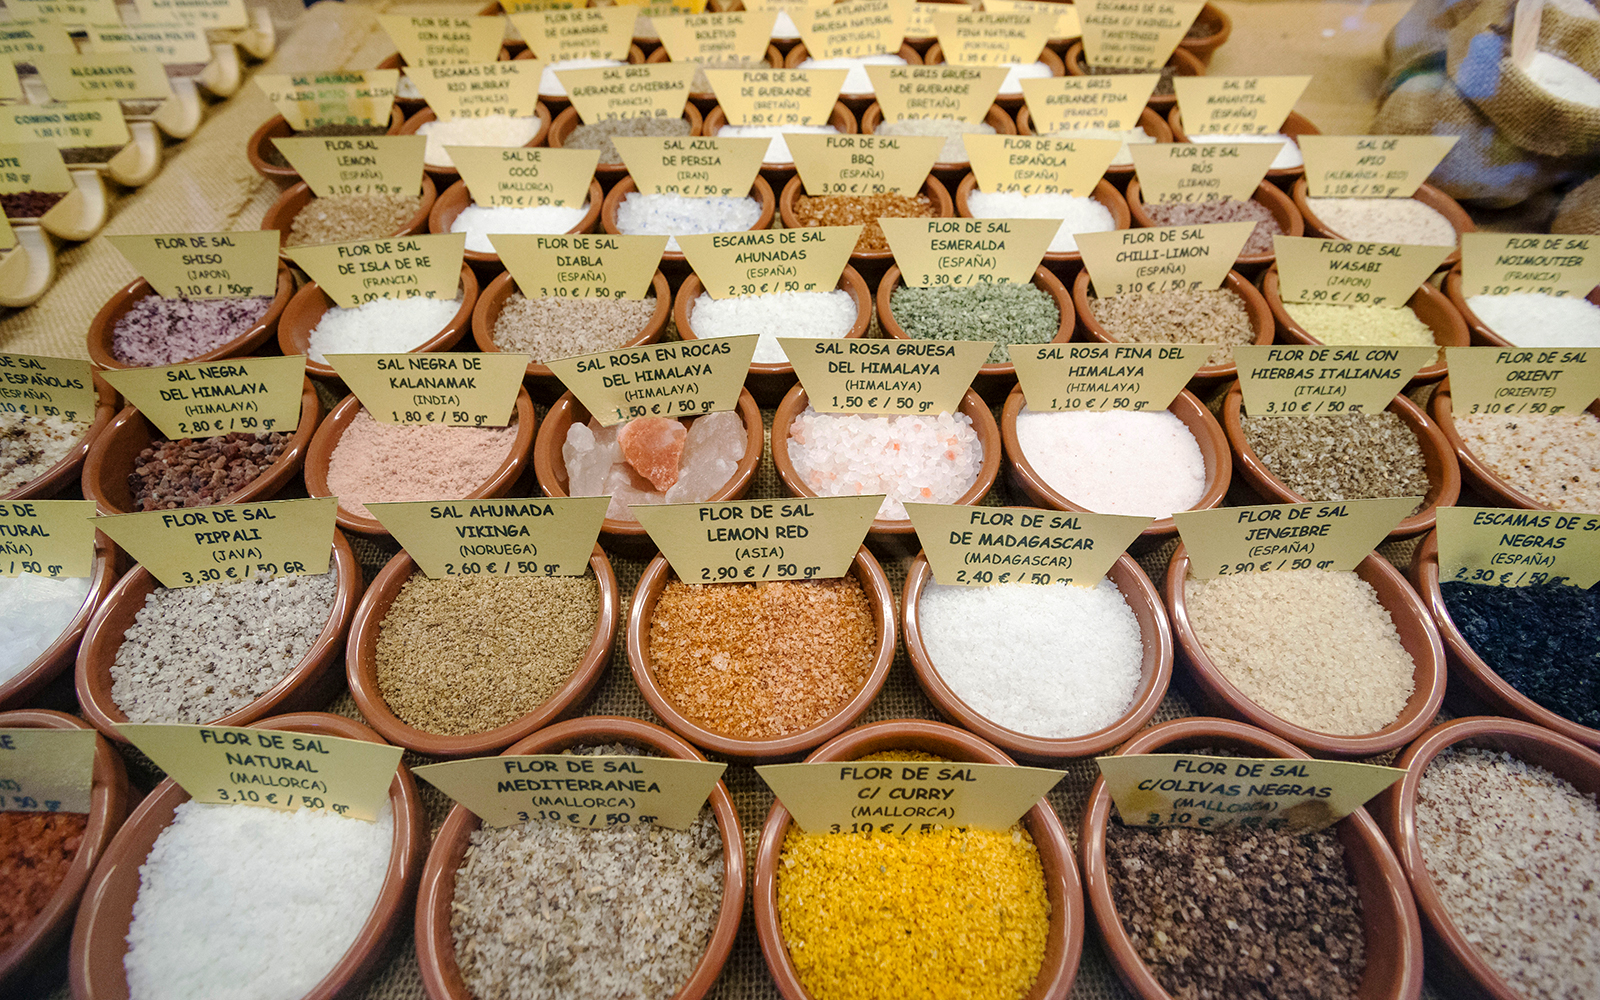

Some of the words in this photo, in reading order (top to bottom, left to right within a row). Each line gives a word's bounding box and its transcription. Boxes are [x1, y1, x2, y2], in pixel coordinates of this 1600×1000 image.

[432, 67, 480, 78] ESCAMAS
[483, 65, 496, 76] DE
[501, 65, 519, 74] SAL
[603, 70, 621, 80] SAL
[626, 68, 650, 78] GRIS
[890, 69, 908, 78] SAL
[913, 69, 938, 78] GRIS
[942, 69, 981, 79] GRUESA
[899, 83, 912, 93] DE
[916, 84, 969, 94] GUERANDE
[1065, 81, 1082, 89] SAL
[1087, 79, 1112, 89] GRIS
[1223, 81, 1239, 90] SAL
[1244, 79, 1257, 90] DE
[741, 87, 753, 96] DE
[758, 87, 811, 96] GUERANDE
[325, 140, 353, 150] FLOR
[357, 140, 378, 150] SAL
[664, 140, 684, 150] SAL
[690, 140, 718, 150] AZUL
[1356, 140, 1376, 150] SAL
[1382, 139, 1398, 150] DE
[337, 156, 376, 166] LEMON
[503, 151, 523, 161] SAL
[527, 151, 541, 162] DE
[662, 156, 676, 166] DE
[681, 156, 721, 166] PERSIA
[852, 154, 874, 166] BBQ
[1009, 154, 1066, 167] ESPAÑOLA
[1357, 156, 1386, 166] APIO
[509, 165, 538, 177] COCÓ
[1191, 161, 1212, 173] RÚS
[677, 171, 709, 181] (IRAN)
[840, 168, 884, 180] (ESPAÑA)
[498, 182, 553, 192] (MALLORCA)
[713, 234, 774, 248] ESCAMAS
[780, 232, 795, 243] DE
[802, 231, 826, 242] SAL
[931, 240, 1005, 250] ESMERALDA
[182, 254, 222, 265] SHISO
[735, 250, 806, 263] AHUNADAS
[1116, 246, 1209, 262] CHILLI-LIMON
[338, 263, 356, 275] DE
[360, 261, 390, 272] ISLA
[395, 258, 411, 270] DE
[415, 256, 431, 267] RE
[557, 256, 602, 266] DIABLA
[1330, 260, 1382, 272] WASABI
[1496, 256, 1584, 267] NOIMOUTIER
[187, 270, 230, 281] (JAPON)
[815, 343, 843, 354] SAL
[850, 343, 890, 355] ROSA
[896, 344, 955, 356] GRUESA
[1037, 348, 1064, 359] SAL
[1070, 348, 1108, 358] ROSA
[1115, 347, 1151, 358] FINA
[1158, 348, 1184, 359] DEL
[1268, 350, 1304, 361] FLOR
[1309, 349, 1330, 361] DE
[1333, 350, 1359, 361] SAL
[1366, 350, 1398, 361] CON
[378, 359, 404, 370] SAL
[409, 358, 457, 370] NEGRA
[463, 358, 481, 370] DE
[577, 357, 605, 373] SAL
[610, 352, 650, 367] ROSA
[656, 348, 676, 361] EN
[682, 343, 730, 358] ROCAS
[167, 369, 196, 382] SAL
[198, 366, 248, 379] NEGRA
[829, 361, 855, 373] DEL
[862, 362, 939, 375] HIMALAYA
[1069, 366, 1143, 377] HIMALAYA
[1251, 368, 1314, 379] HIERBAS
[1318, 368, 1401, 379] ITALIANAS
[6, 373, 84, 389] ESPAÑOLAS
[603, 374, 630, 388] DEL
[635, 364, 712, 382] HIMALAYA
[1506, 370, 1563, 381] ORIENT
[390, 378, 476, 388] KALANAMAK
[160, 389, 188, 401] DEL
[192, 383, 268, 398] HIMALAYA
[625, 383, 698, 402] (HIMALAYA)
[1294, 386, 1346, 397] (ITALIA)
[413, 395, 460, 407] (INDIA)
[178, 420, 210, 434] 2,80
[214, 420, 224, 430] €
[230, 418, 234, 429] /
[240, 417, 258, 428] 50
[263, 419, 276, 430] gr
[430, 506, 463, 518] SAL
[470, 504, 554, 517] AHUMADA
[970, 511, 1014, 526] FLOR
[1021, 515, 1044, 528] DE
[1050, 517, 1081, 530] SAL
[195, 529, 262, 545] PIPPALI
[456, 525, 530, 538] VIKINGA
[708, 527, 768, 542] LEMON
[776, 525, 808, 538] RED
[1245, 524, 1331, 541] JENGIBRE
[950, 531, 972, 545] DE
[978, 533, 1094, 550] MADAGASCAR
[1499, 534, 1566, 548] NEGRAS
[213, 547, 262, 563] (JAVA)
[460, 544, 537, 558] (NORUEGA)
[736, 546, 784, 561] (ASIA)
[1249, 541, 1314, 558] (ESPAÑA)
[965, 552, 1072, 569] (MADAGASCAR)
[1491, 552, 1555, 568] (ESPAÑA)
[445, 562, 480, 577] 2,60
[486, 562, 497, 573] €
[504, 562, 510, 574] /
[518, 561, 537, 577] 50
[544, 564, 561, 578] gr
[226, 752, 318, 773] NATURAL
[504, 760, 558, 774] FLOR
[566, 760, 594, 772] DE
[604, 761, 643, 774] SAL
[1174, 760, 1227, 775] FLOR
[1235, 764, 1265, 777] DE
[1270, 762, 1309, 777] SAL
[498, 779, 660, 793] MEDITERRANEA
[1138, 779, 1241, 796] C/OLIVAS
[1247, 784, 1332, 798] NEGRAS
[858, 787, 881, 799] C/
[889, 788, 954, 800] CURRY
[532, 796, 635, 809] (MALLORCA)
[852, 806, 954, 819] (MALLORCA)
